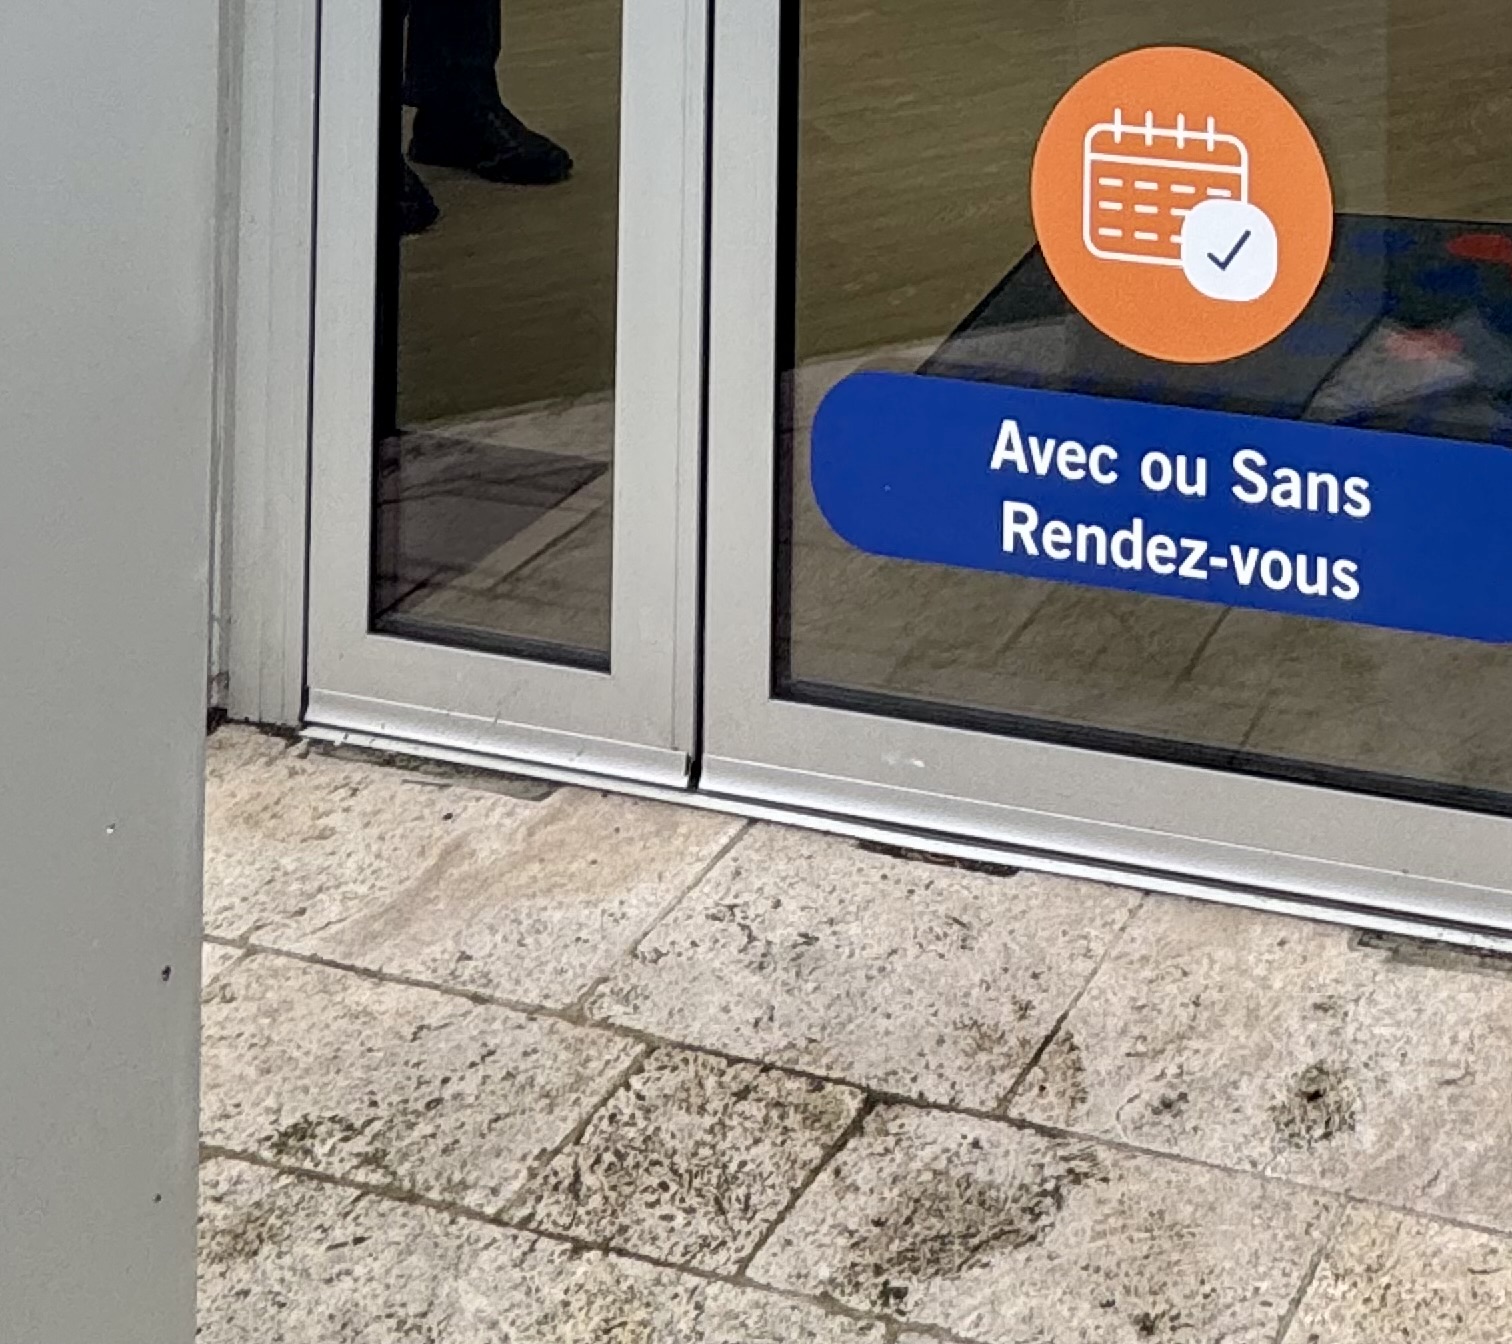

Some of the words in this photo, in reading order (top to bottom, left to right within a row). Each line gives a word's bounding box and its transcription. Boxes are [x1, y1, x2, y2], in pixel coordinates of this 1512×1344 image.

[990, 418, 1119, 485] Avec
[1139, 450, 1207, 498] ou
[1231, 447, 1372, 519] Sans
[1001, 500, 1361, 601] Rendez-vous
